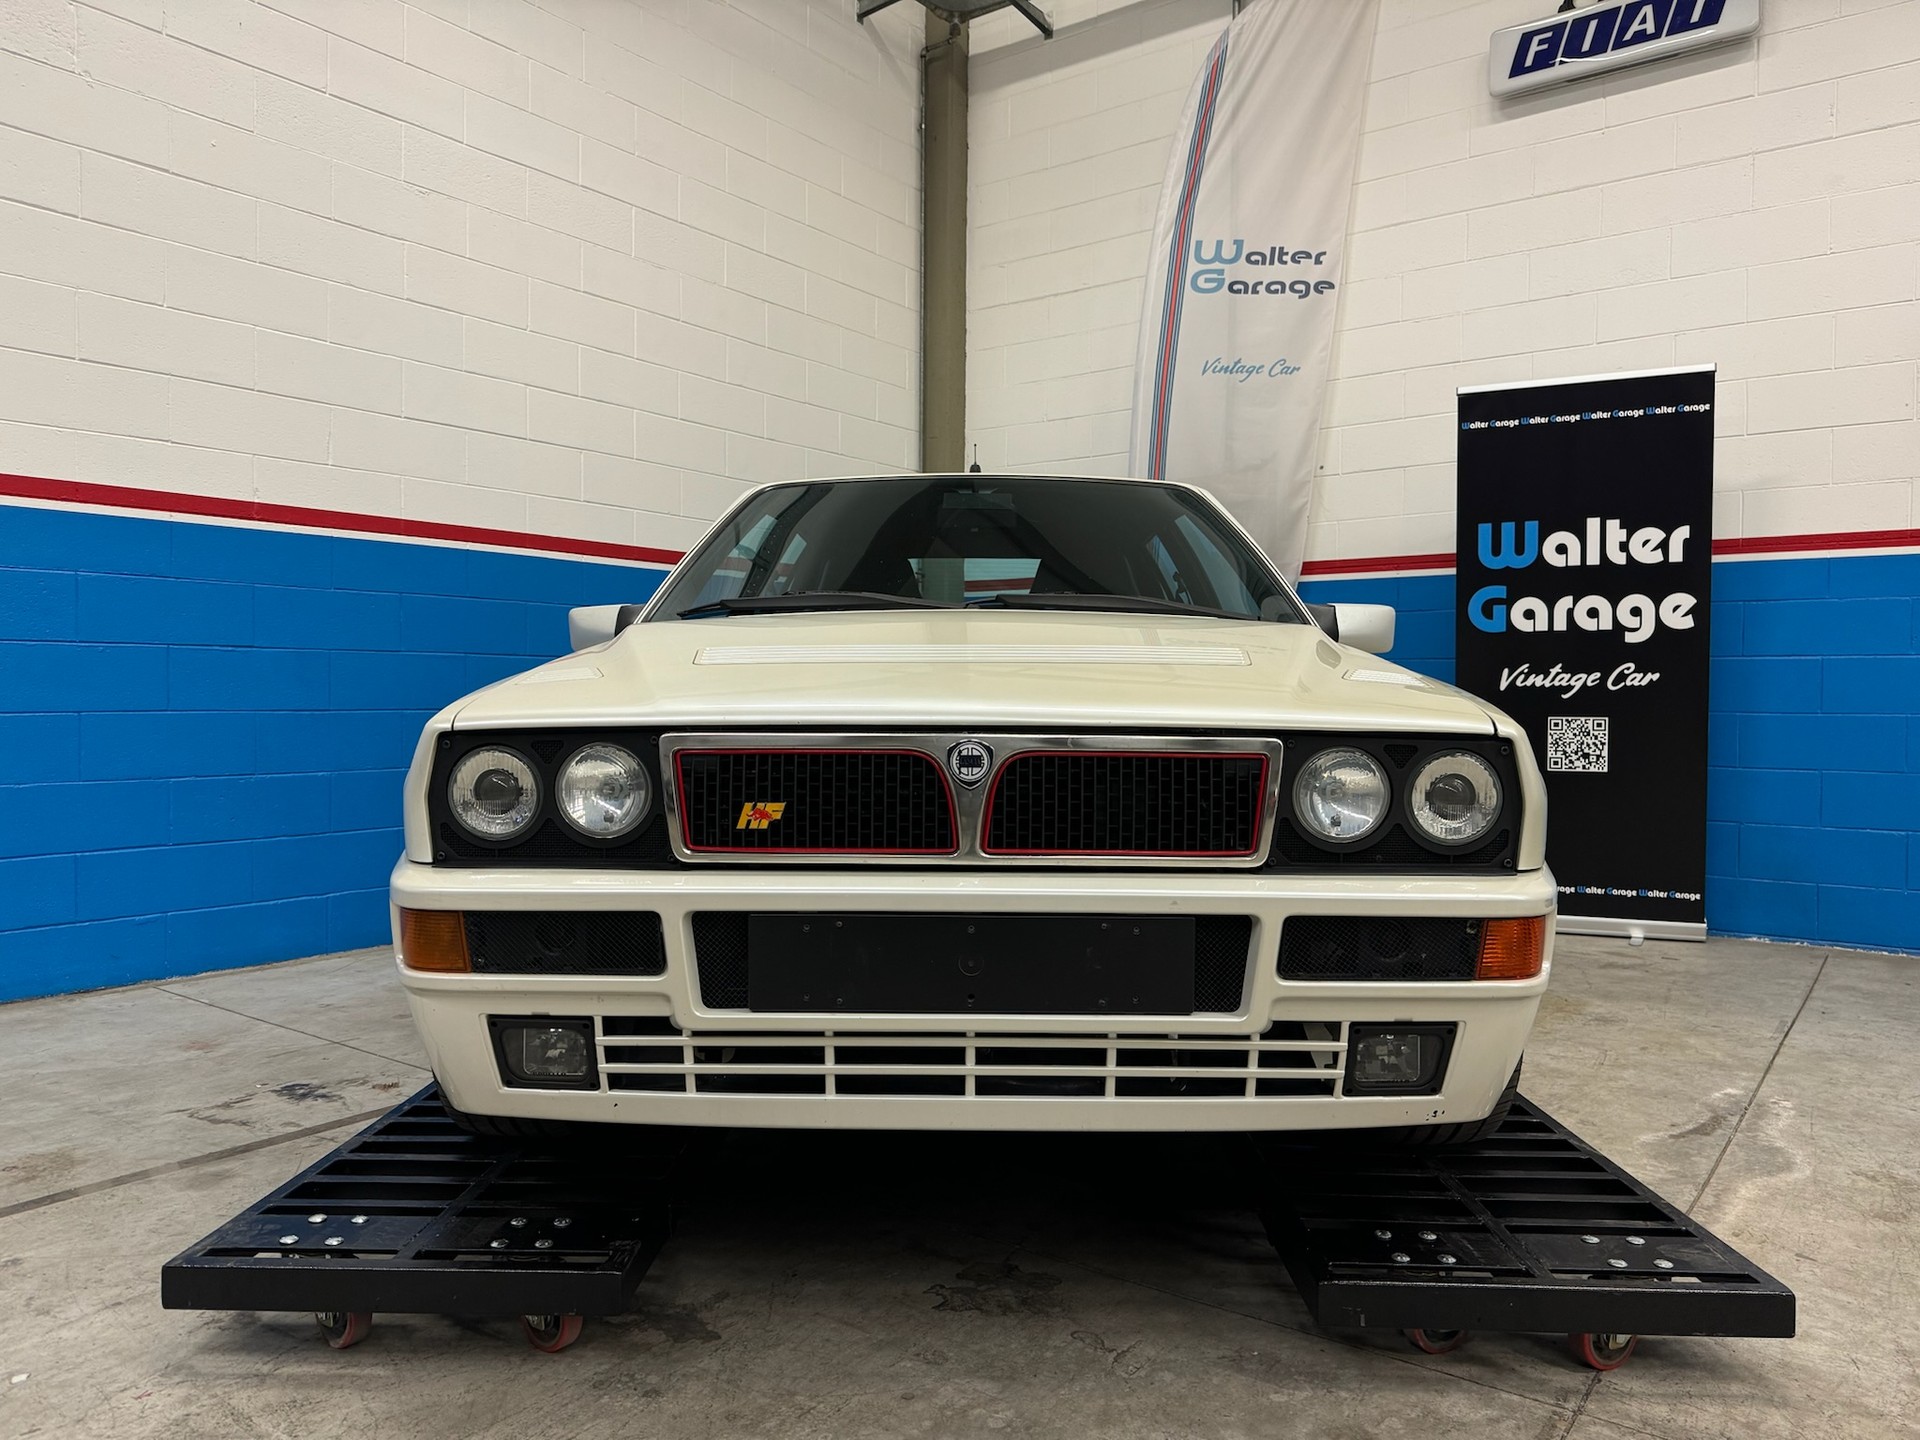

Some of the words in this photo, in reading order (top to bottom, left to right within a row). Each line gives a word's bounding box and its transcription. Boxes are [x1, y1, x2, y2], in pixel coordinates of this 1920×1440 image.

[1194, 239, 1327, 266] Walter
[1190, 268, 1335, 299] Garage
[1201, 357, 1265, 383] Vintage
[1268, 358, 1301, 378] Car
[1461, 419, 1489, 430] Walter
[1490, 418, 1519, 429] Garage
[1520, 415, 1549, 425] Walter
[1550, 413, 1581, 424] Garage
[1582, 410, 1611, 420] Walter
[1612, 407, 1644, 419] Garage
[1645, 405, 1676, 415] Walter
[1677, 402, 1711, 414] Garage
[1478, 517, 1690, 570] Walter
[1467, 585, 1697, 643] Garage
[1499, 663, 1601, 699] Vintage
[1606, 662, 1660, 690] Car
[736, 801, 787, 829] HF
[1557, 885, 1575, 894] rage
[1576, 885, 1605, 895] Walter
[1606, 886, 1637, 897] Garage
[1638, 888, 1668, 898] Walter
[1669, 890, 1701, 901] Garage
